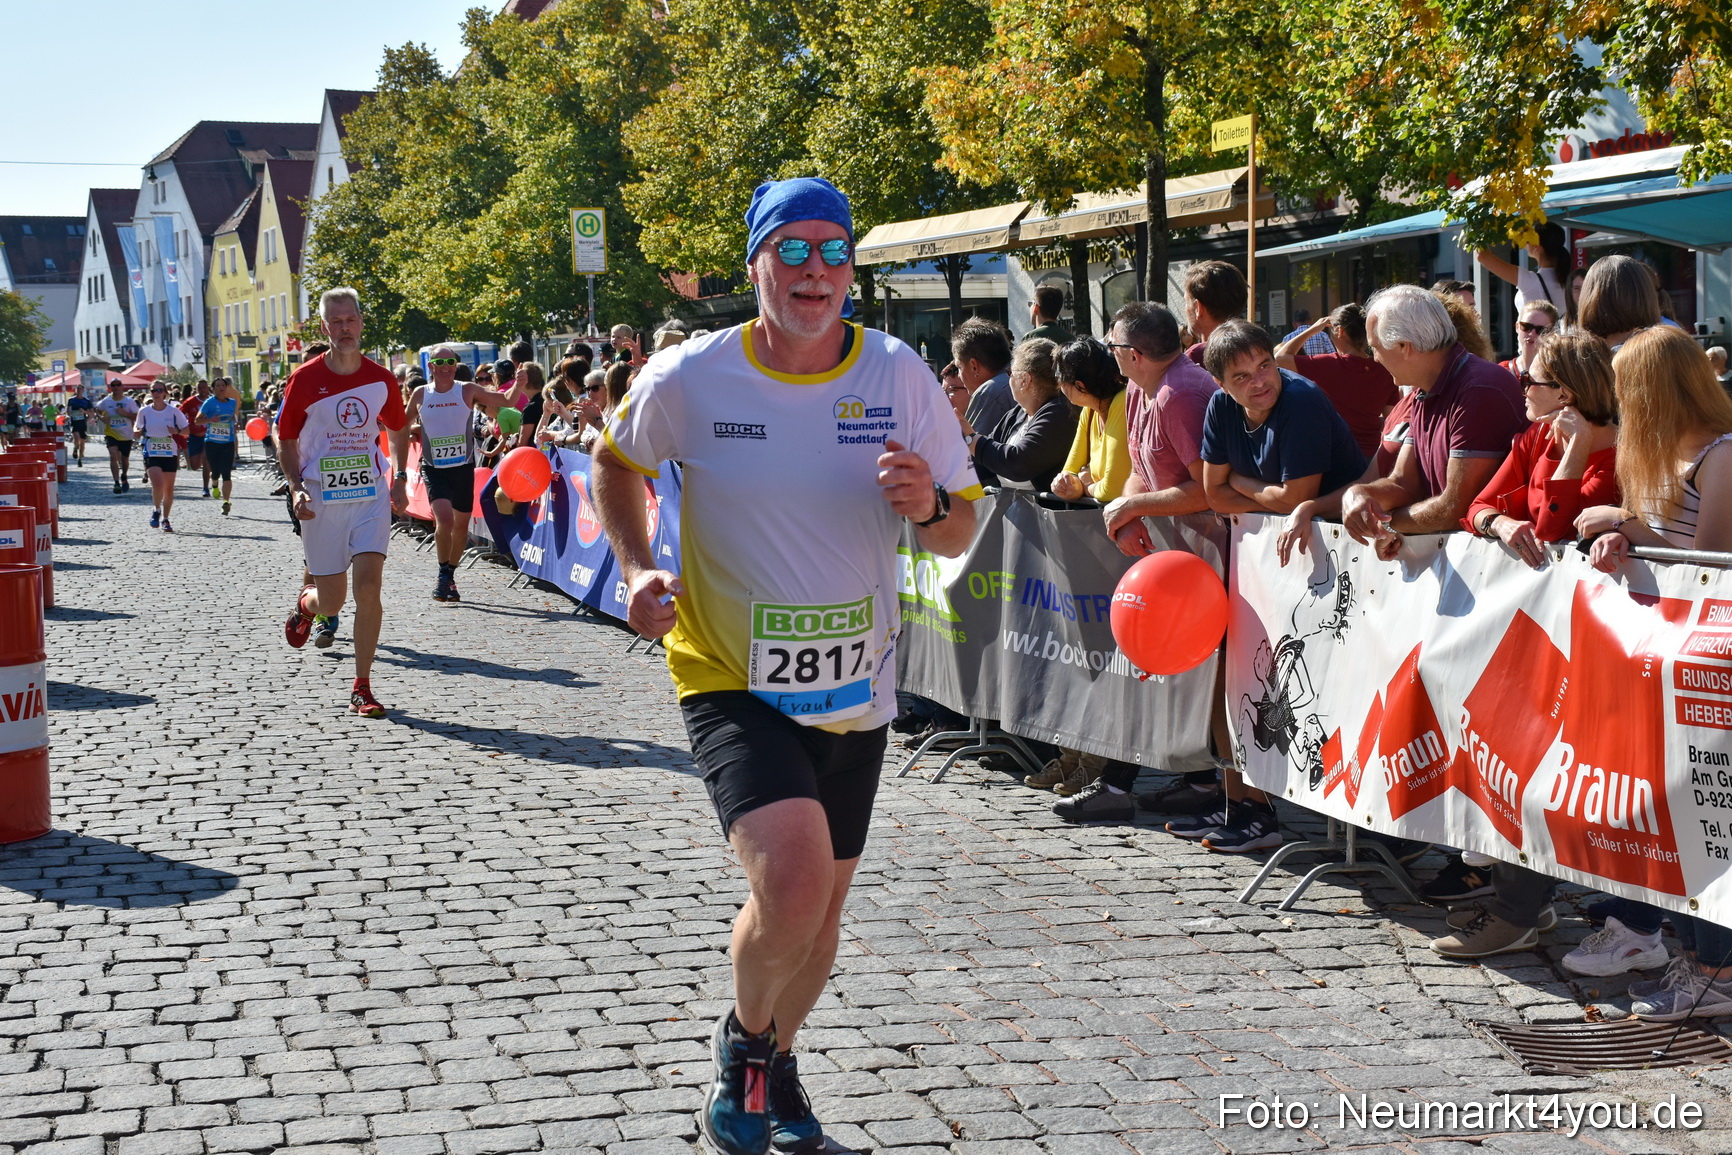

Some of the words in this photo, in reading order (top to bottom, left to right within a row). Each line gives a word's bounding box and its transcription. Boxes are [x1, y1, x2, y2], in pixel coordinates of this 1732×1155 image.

[1219, 126, 1250, 142] Toiletten
[837, 401, 863, 419] 20
[867, 408, 891, 417] JAHRE
[212, 427, 229, 435] 2364
[714, 422, 767, 436] BOCK
[433, 436, 465, 446] BOCK
[837, 434, 888, 445] Stadtlauf
[435, 446, 463, 458] 2721
[324, 455, 369, 470] BOCK
[327, 471, 370, 488] 2456
[331, 489, 369, 499] RÜDIGER
[763, 601, 871, 637] BOCK
[767, 640, 866, 685] 2817
[1550, 701, 1561, 719] Seit
[1558, 677, 1569, 700] 1929
[1380, 729, 1444, 791] Braun
[1458, 706, 1519, 811] Braun
[1689, 744, 1730, 767] Braun
[1407, 775, 1430, 791] Sicher
[1430, 769, 1439, 779] ist
[1691, 767, 1714, 787] Am
[1543, 740, 1660, 836] Braun
[1700, 819, 1726, 839] Tel.
[1587, 831, 1621, 853] Sicher
[1624, 838, 1641, 856] ist
[1643, 843, 1680, 864] sicher
[1705, 841, 1730, 861] Fax
